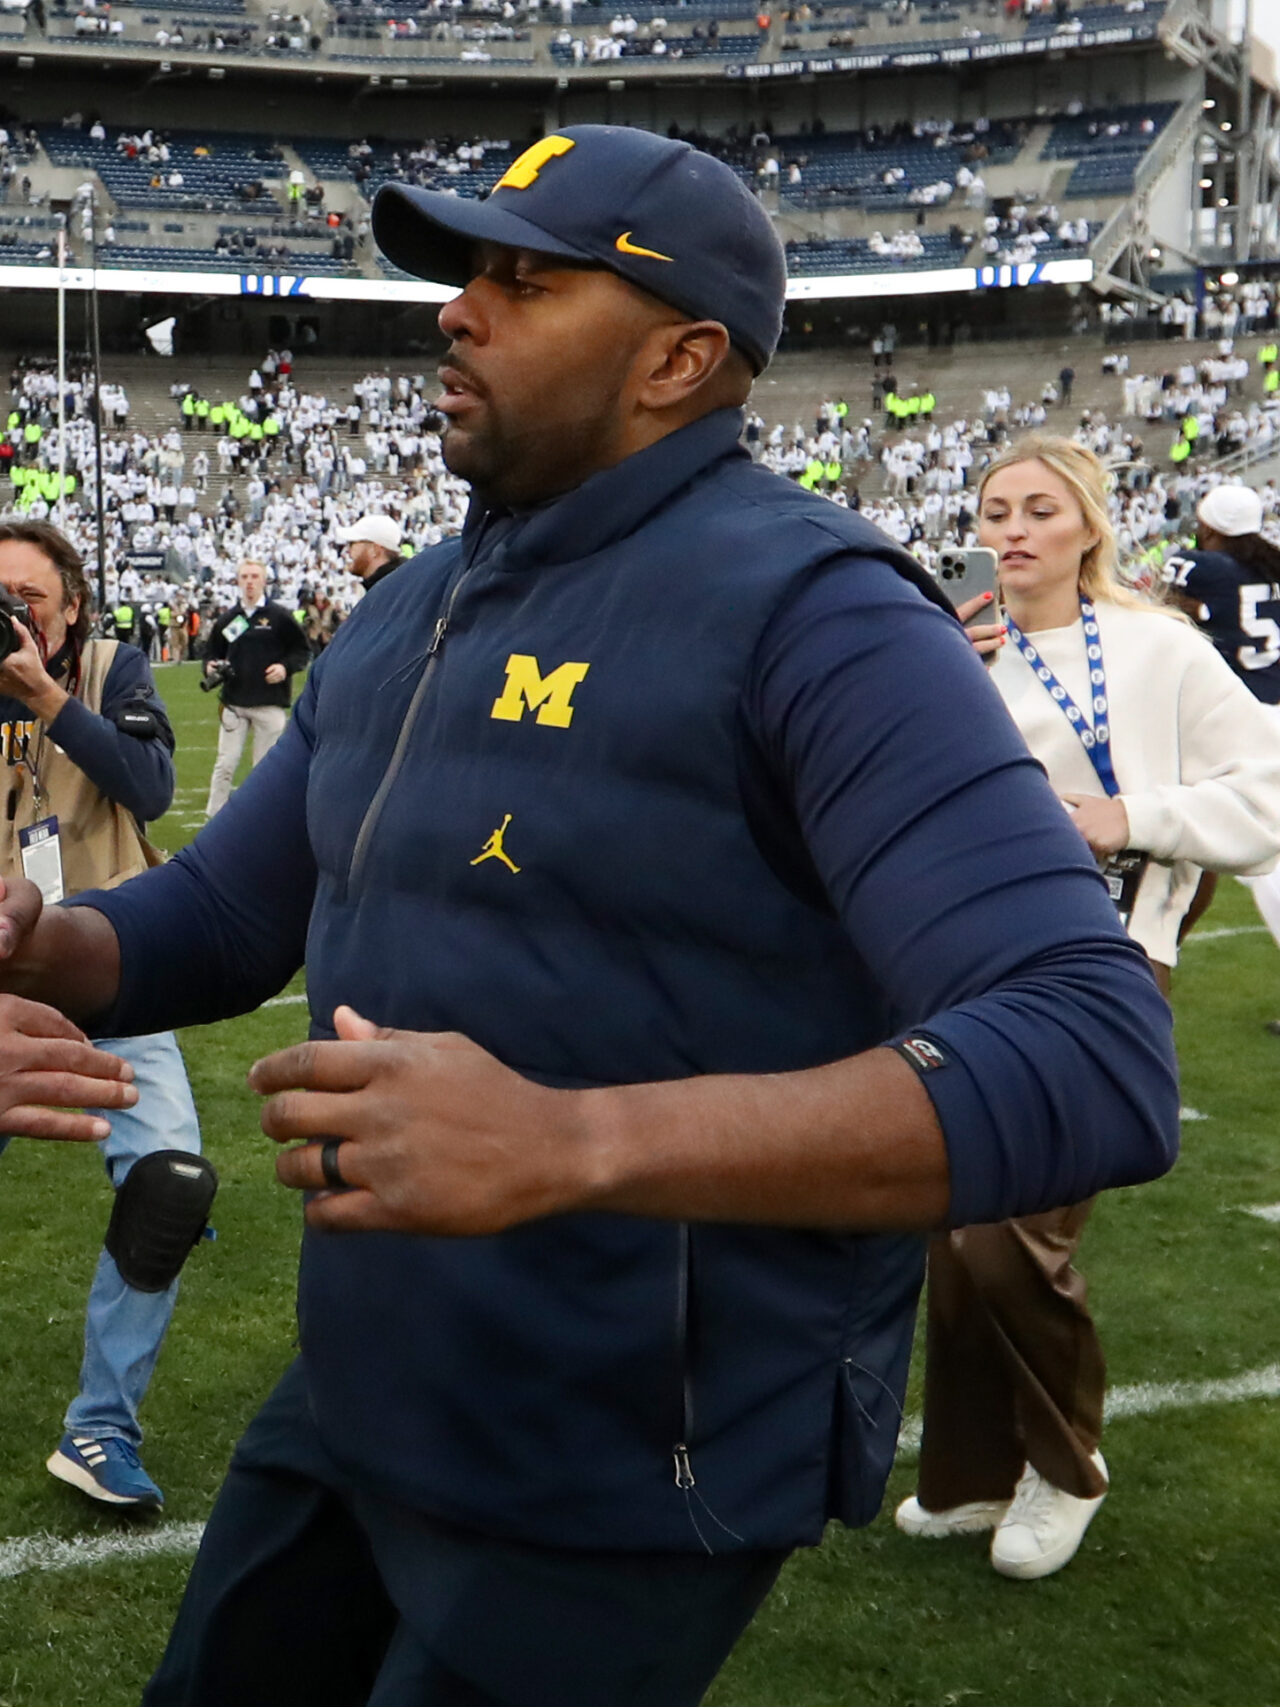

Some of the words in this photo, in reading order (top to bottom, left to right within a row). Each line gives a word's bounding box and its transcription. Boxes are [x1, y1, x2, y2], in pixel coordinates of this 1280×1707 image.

[745, 64, 770, 77] NEED
[773, 61, 803, 76] HELP?
[942, 48, 969, 62] YOUR
[974, 41, 1024, 59] LOCATION
[1162, 556, 1197, 587] 57
[491, 653, 590, 729] M
